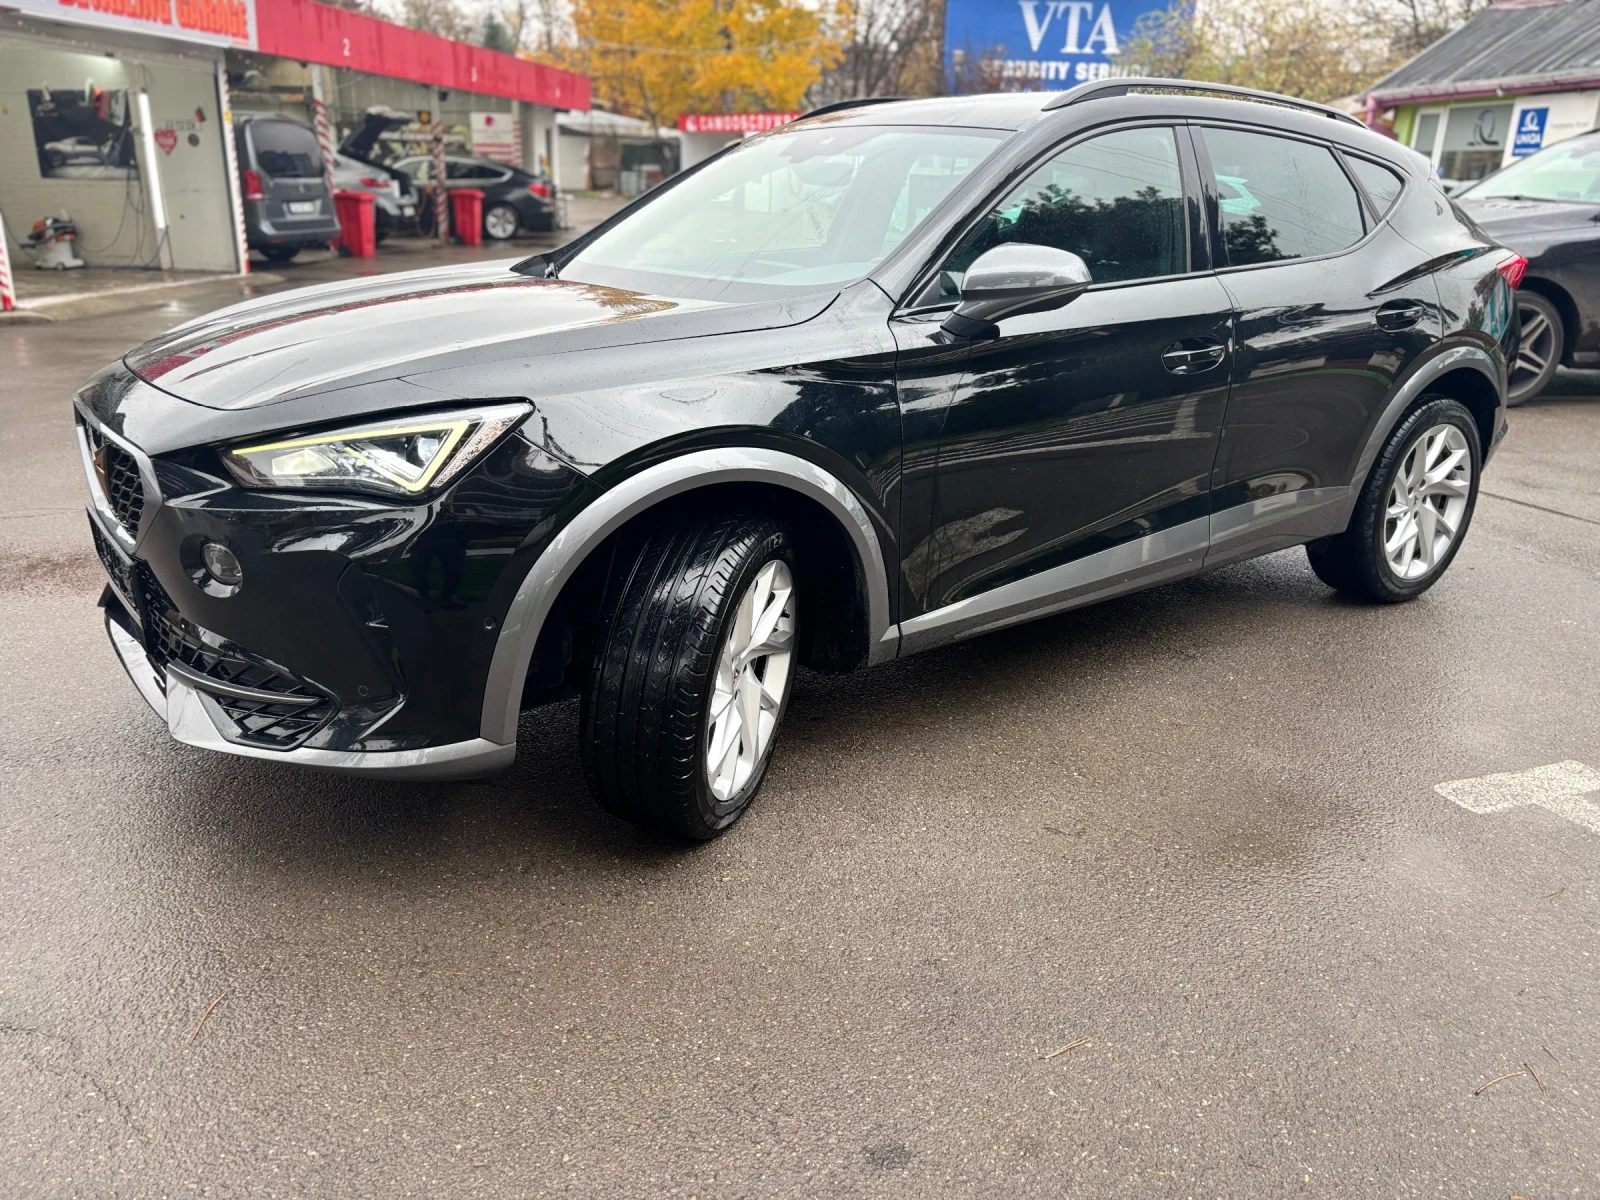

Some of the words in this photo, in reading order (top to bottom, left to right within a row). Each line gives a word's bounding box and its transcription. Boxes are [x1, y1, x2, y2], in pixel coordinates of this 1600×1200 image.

[174, 0, 250, 39] GARAGE
[1018, 0, 1121, 54] VTA
[342, 38, 351, 57] 2
